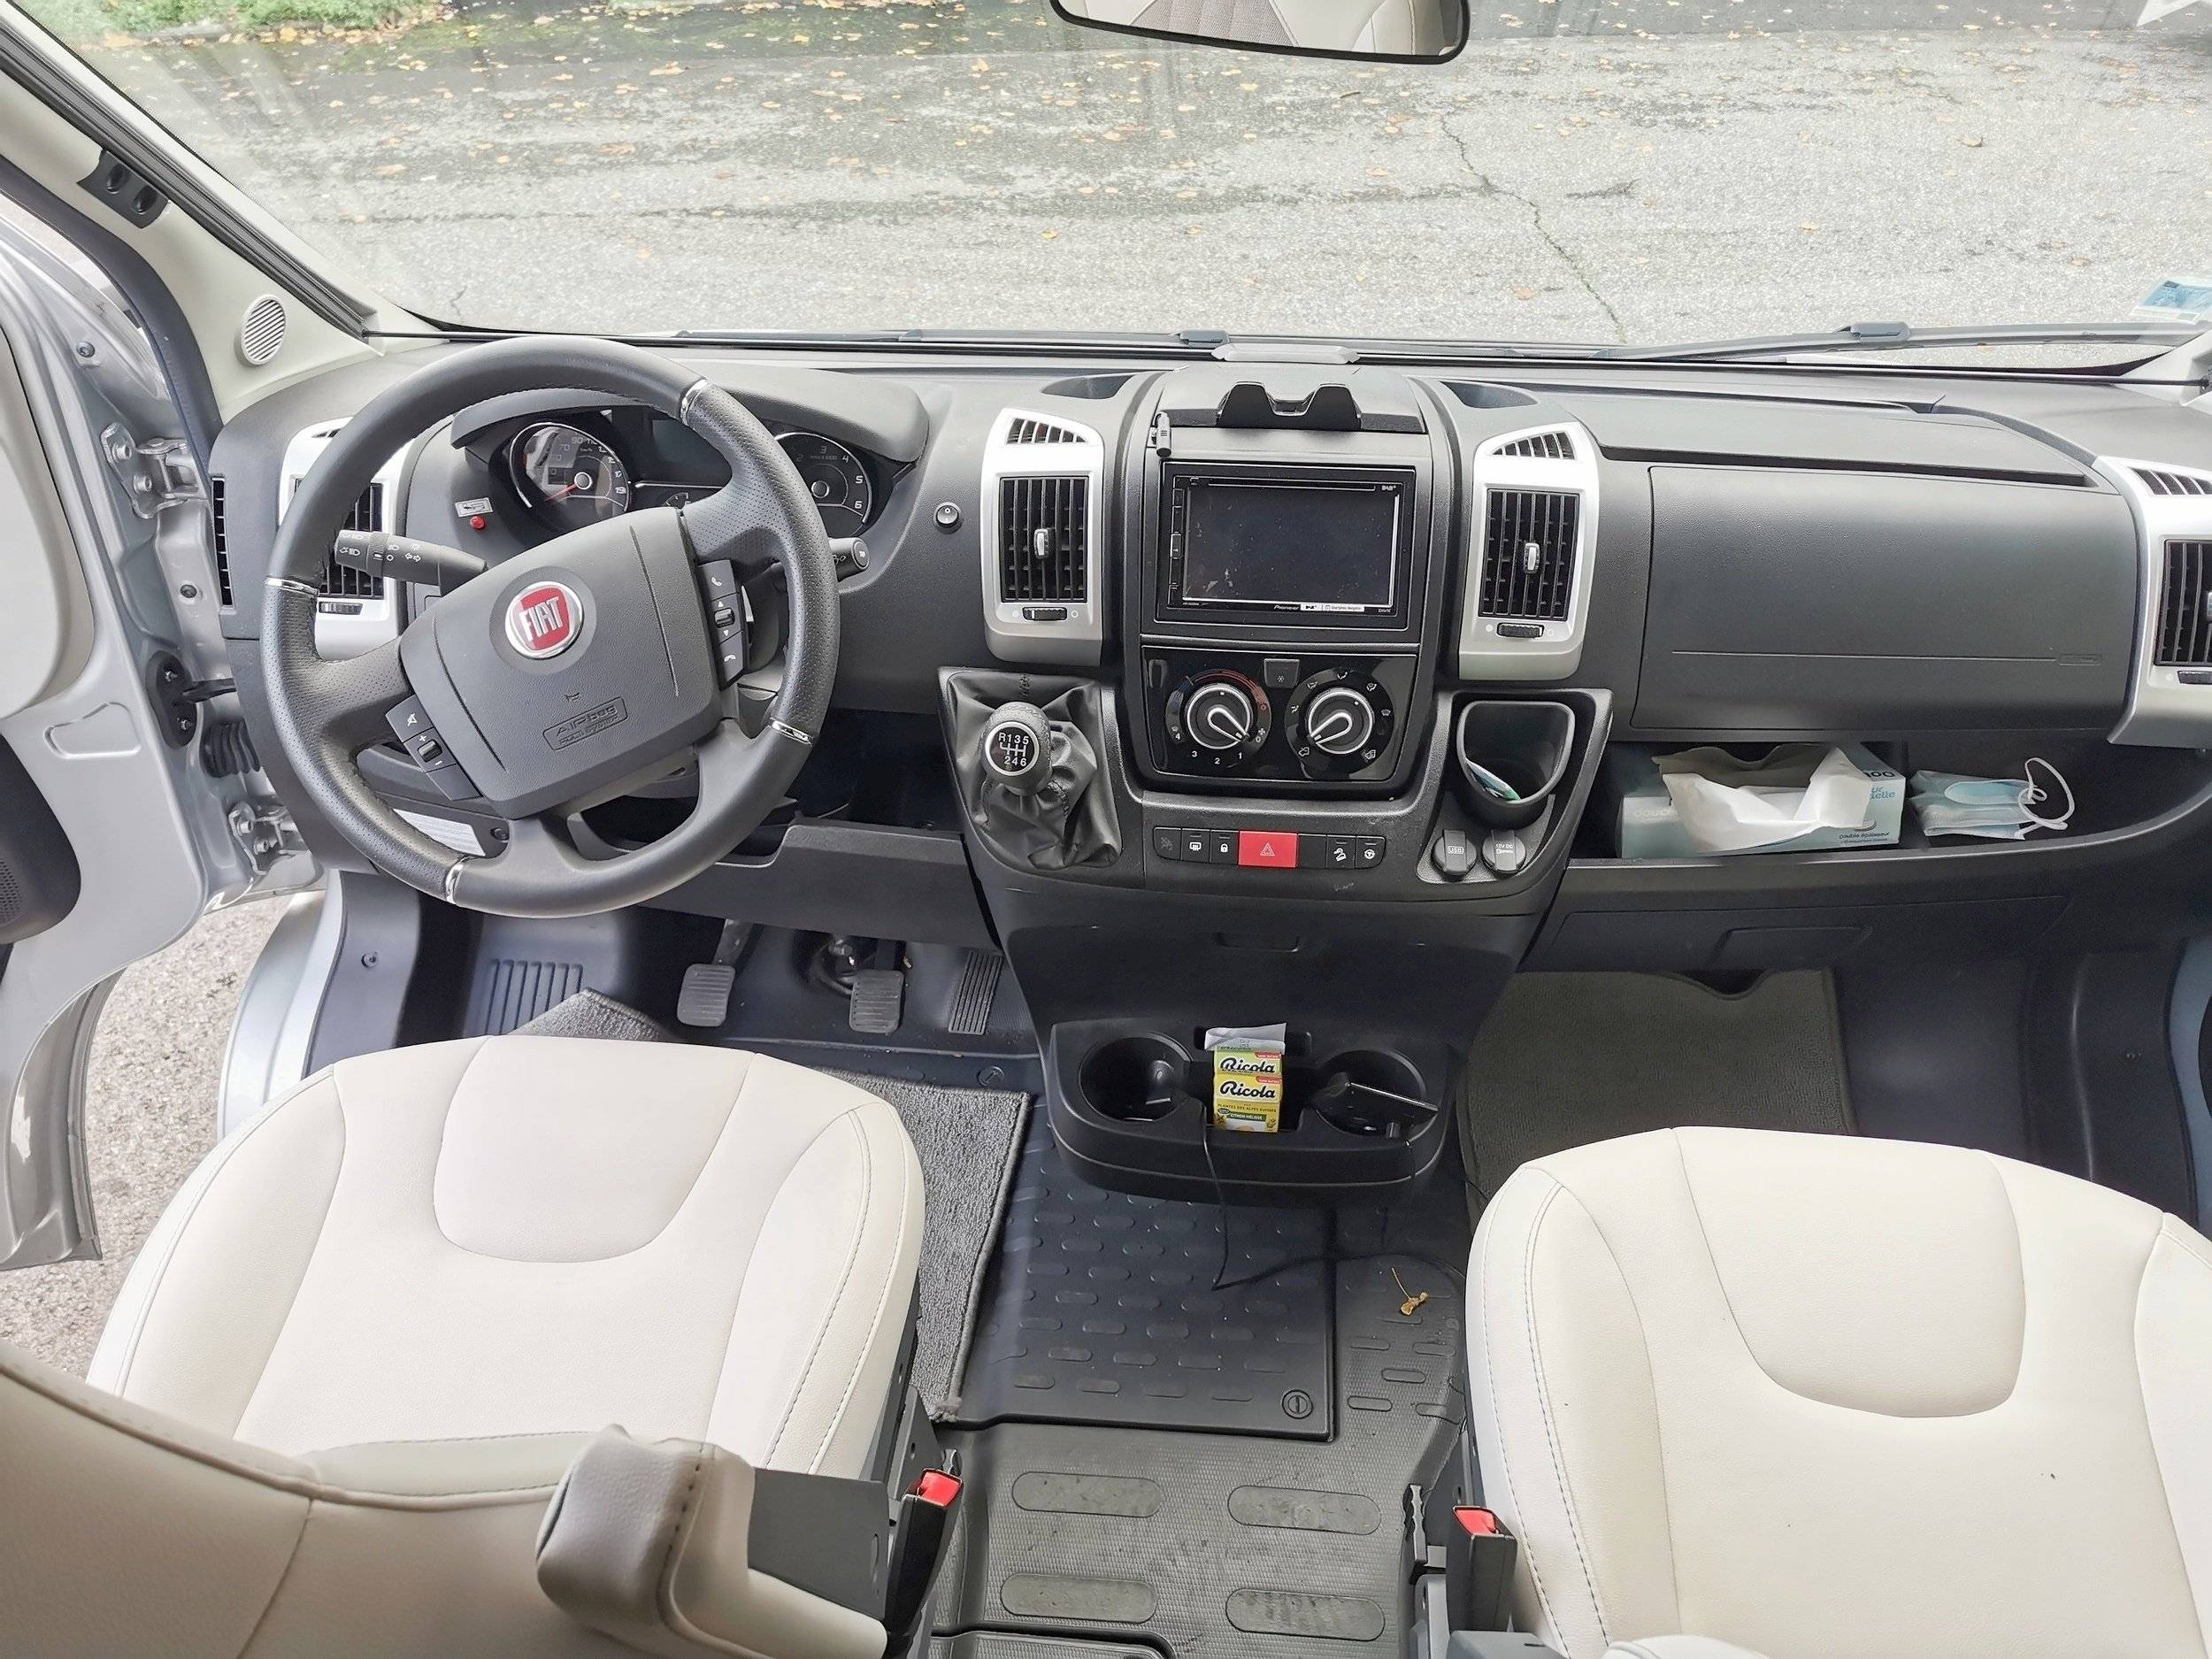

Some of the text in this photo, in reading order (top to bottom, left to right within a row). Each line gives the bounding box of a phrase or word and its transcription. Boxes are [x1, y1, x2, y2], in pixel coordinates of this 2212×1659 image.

[841, 455, 849, 464] 4
[855, 475, 864, 484] 5
[854, 500, 863, 510] 6
[518, 595, 564, 642] FIAT
[1220, 1057, 1275, 1073] Ricola
[1220, 1080, 1276, 1098] Ricola
